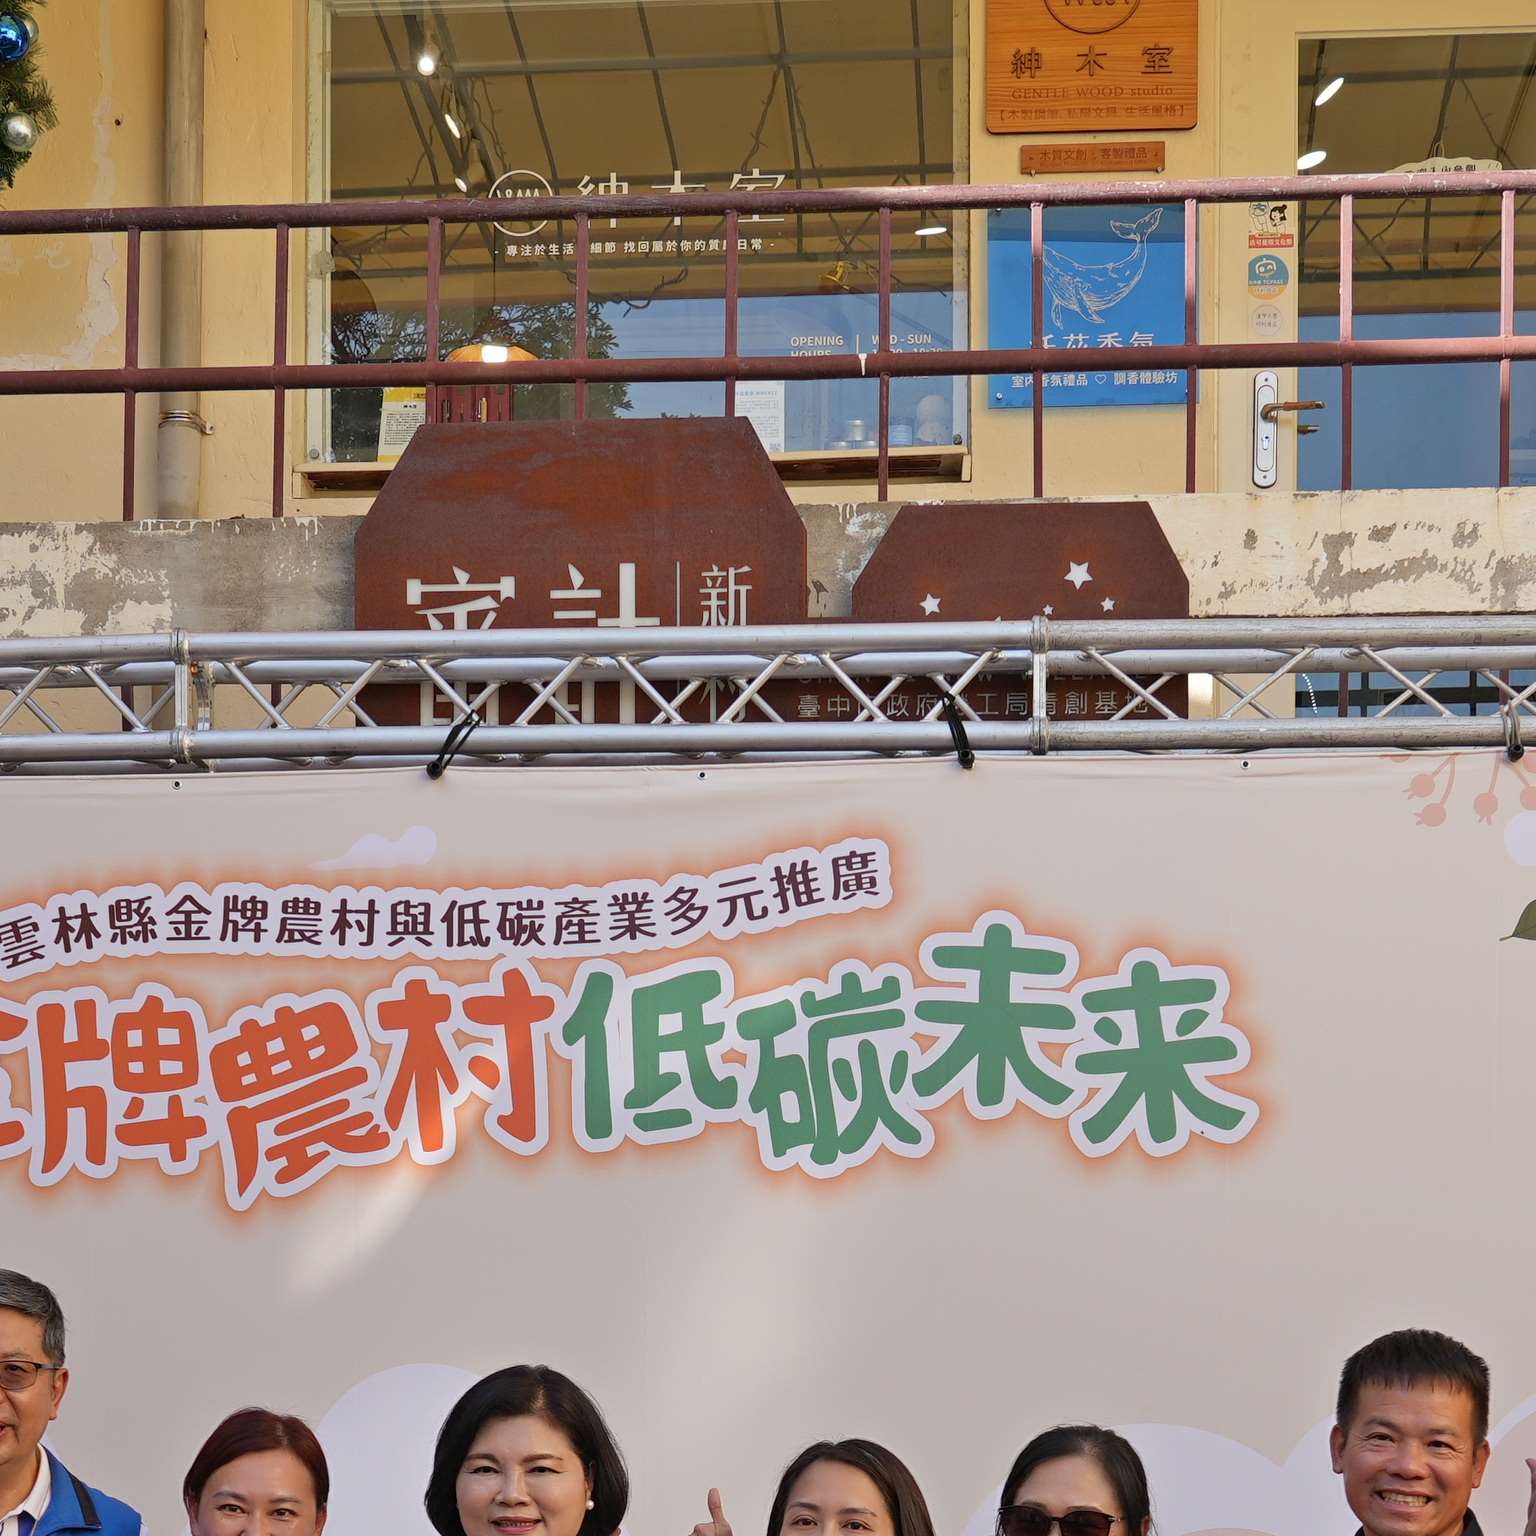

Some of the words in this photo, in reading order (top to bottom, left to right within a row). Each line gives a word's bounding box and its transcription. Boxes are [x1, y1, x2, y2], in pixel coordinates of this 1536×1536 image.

[1010, 43, 1174, 80] 紳木室
[1075, 86, 1125, 98] WOOD
[1129, 84, 1174, 97] studio
[506, 242, 617, 257] 專注於生活細節
[623, 238, 764, 255] 找回屬於你的質日常
[790, 335, 845, 347] OPENING
[872, 334, 899, 345] WD
[907, 334, 933, 344] SUN
